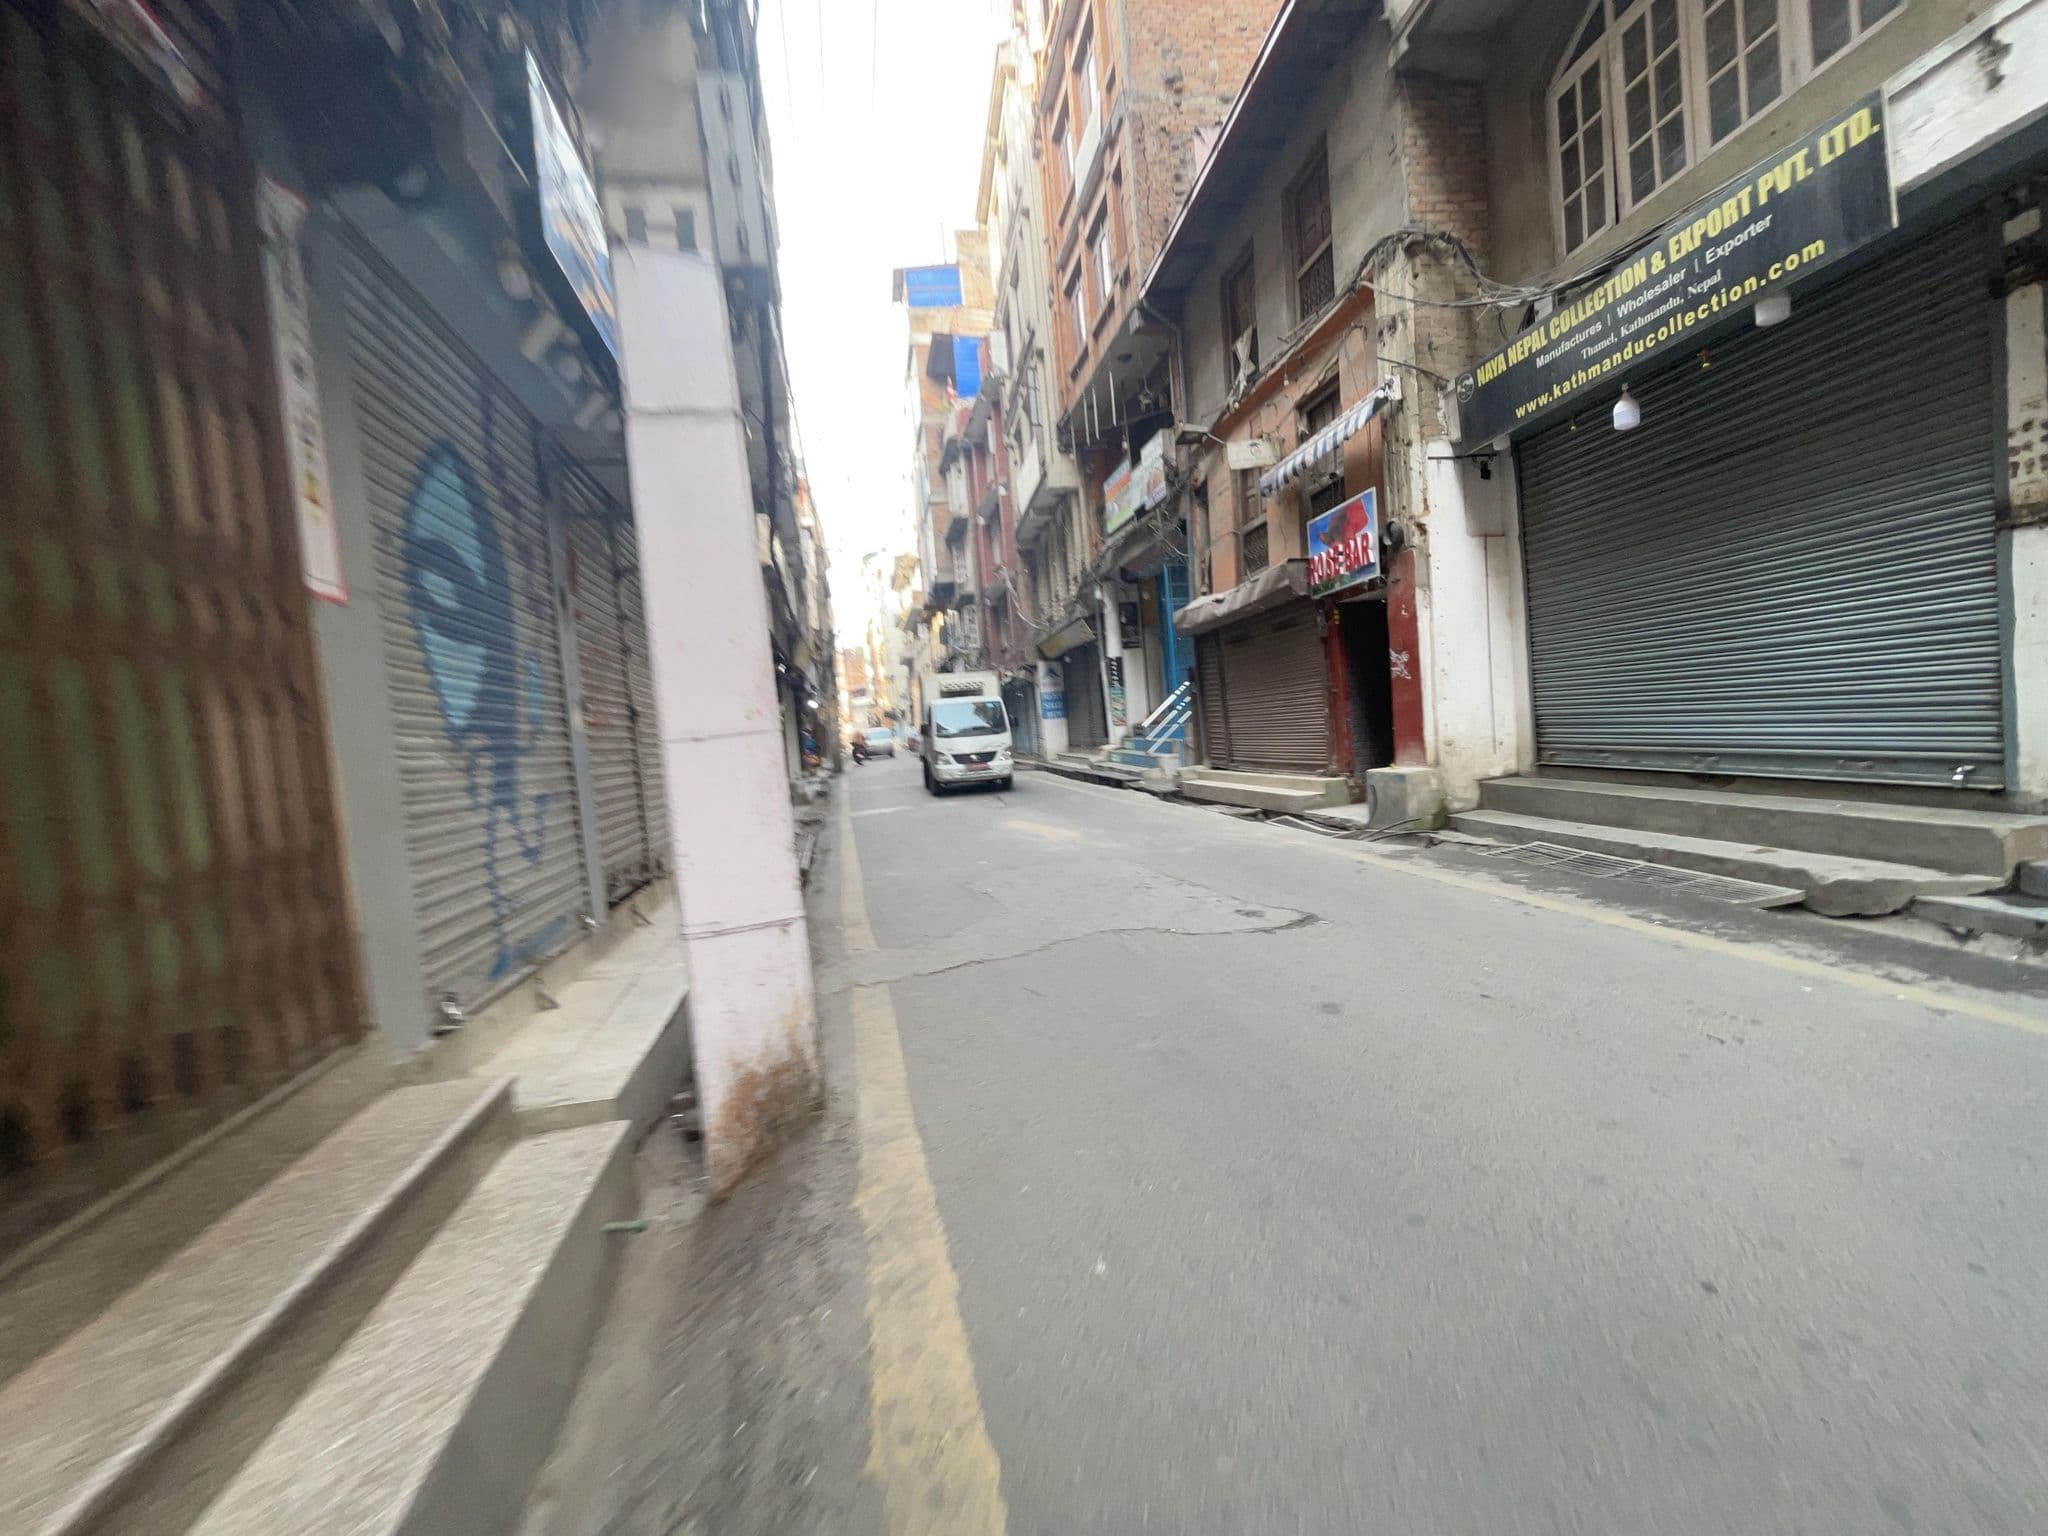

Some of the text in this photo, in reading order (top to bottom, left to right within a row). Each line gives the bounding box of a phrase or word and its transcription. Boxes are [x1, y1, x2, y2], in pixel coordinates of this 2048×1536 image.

[1476, 107, 1881, 387] NAYA NEPAL COLLECTION & EXPORT PVT. LTD.
[1536, 214, 1773, 369] Manufactures Wholesaler Exporter
[1581, 268, 1722, 359] Thamel, Kathmandu, Nepal
[1515, 239, 1825, 419] www.kathmanducollection.com
[1344, 531, 1376, 573] BAR
